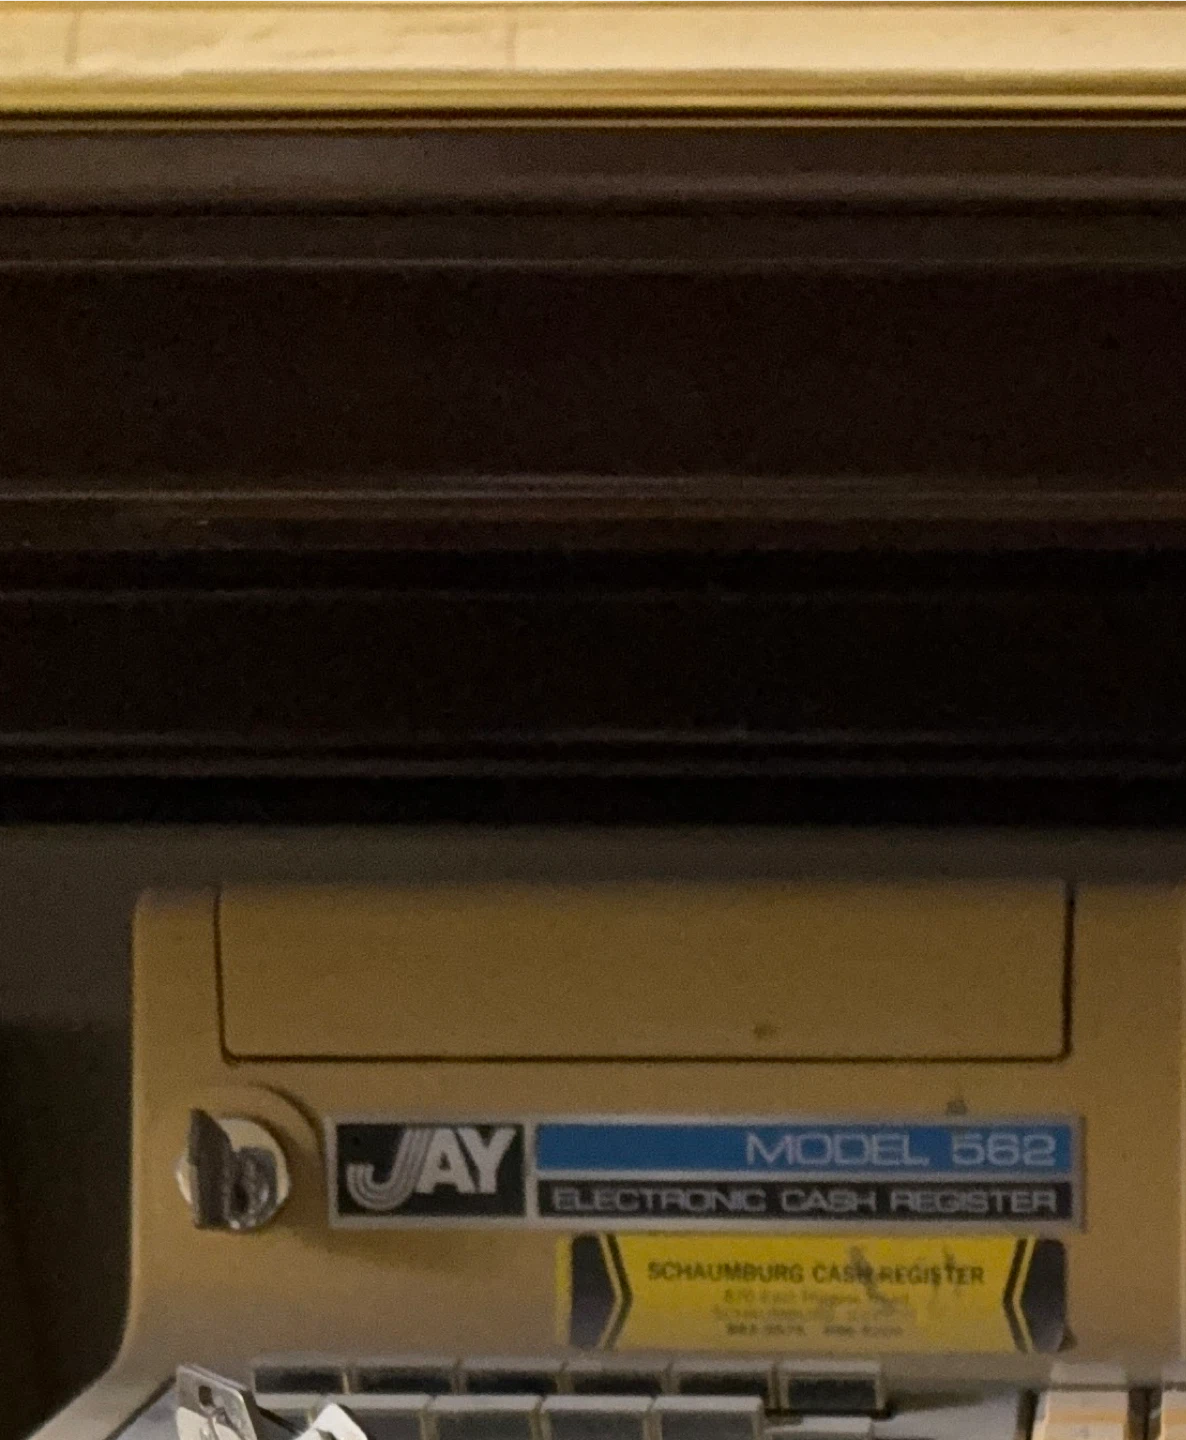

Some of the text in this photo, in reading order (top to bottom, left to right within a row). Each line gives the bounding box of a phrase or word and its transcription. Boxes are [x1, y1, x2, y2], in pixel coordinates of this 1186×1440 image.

[746, 1133, 1055, 1166] MODEL 562
[347, 1127, 516, 1211] JAY
[553, 1188, 1057, 1213] ELECTRONIC CASH REGISTER
[648, 1262, 984, 1285] SCHAUMBURG CASH REGISTER
